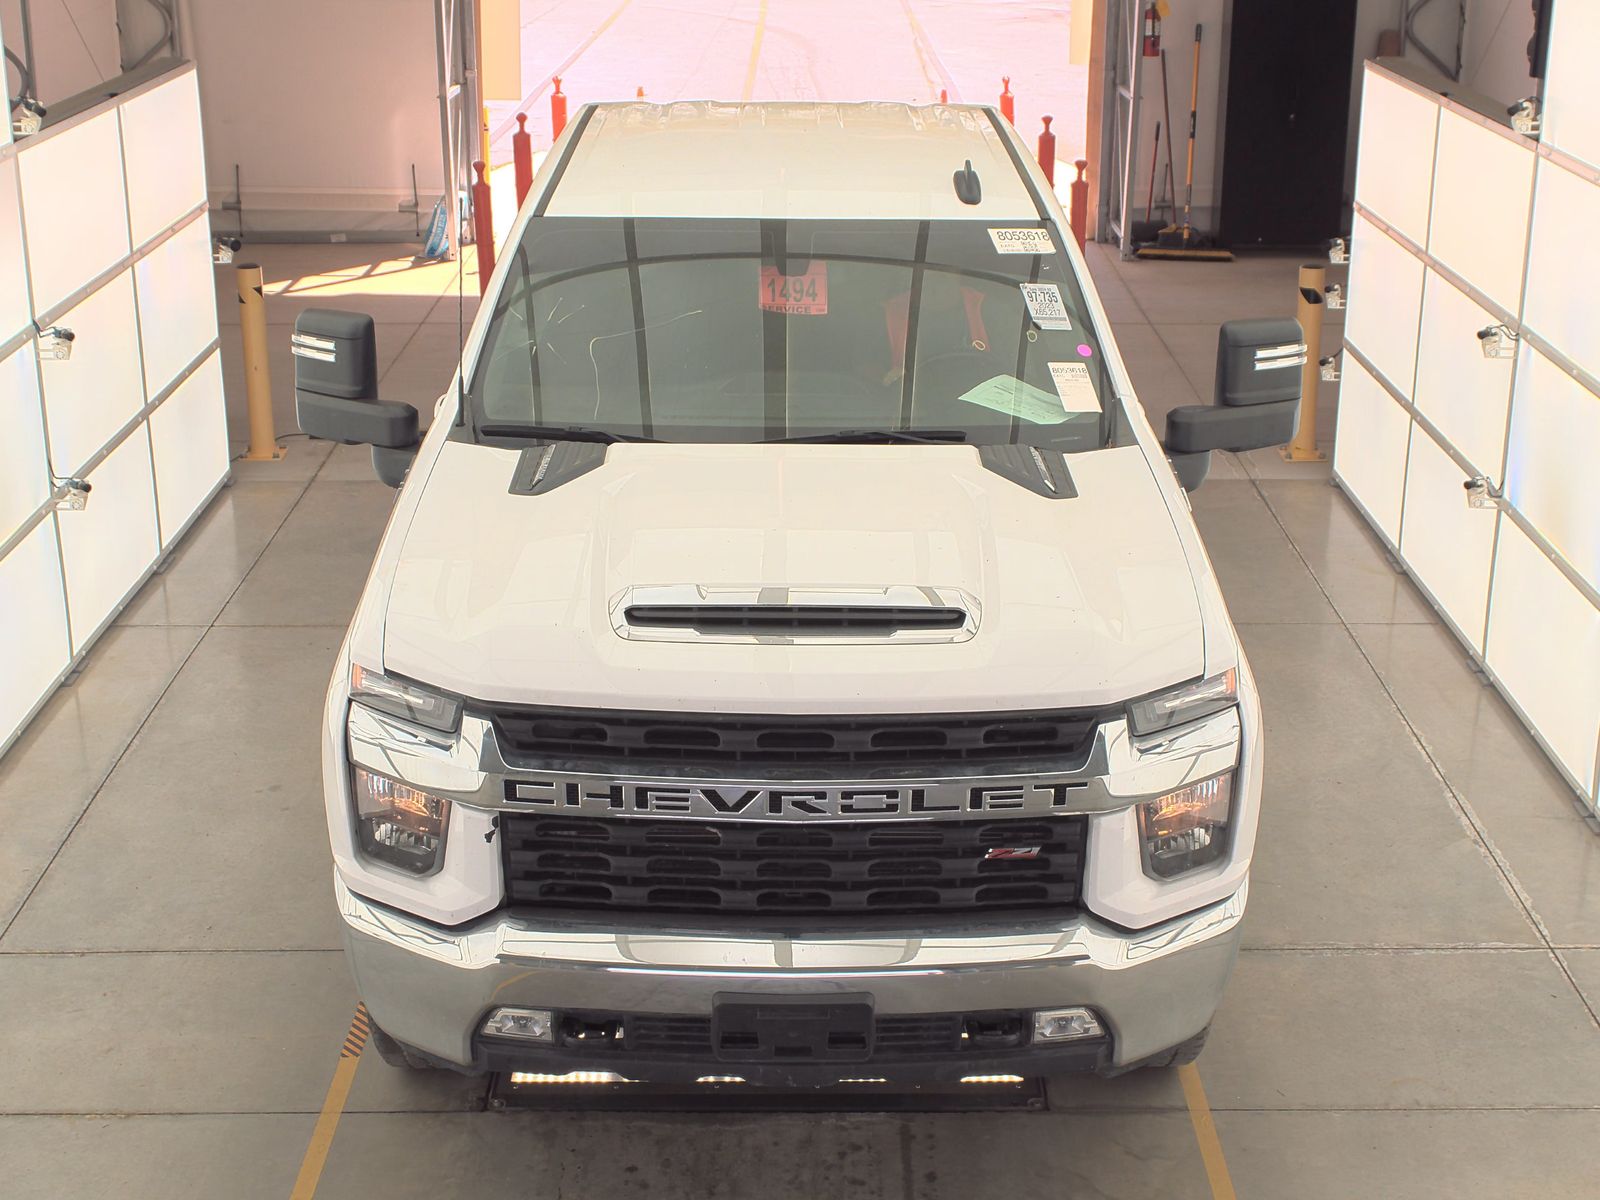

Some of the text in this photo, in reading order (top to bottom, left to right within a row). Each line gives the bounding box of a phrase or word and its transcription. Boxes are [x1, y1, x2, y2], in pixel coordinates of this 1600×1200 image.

[997, 231, 1050, 241] 8053618
[767, 278, 818, 303] 1494
[1027, 291, 1059, 303] 97:735
[503, 780, 1089, 815] CHEVROLET
[984, 846, 1041, 859] Z71
